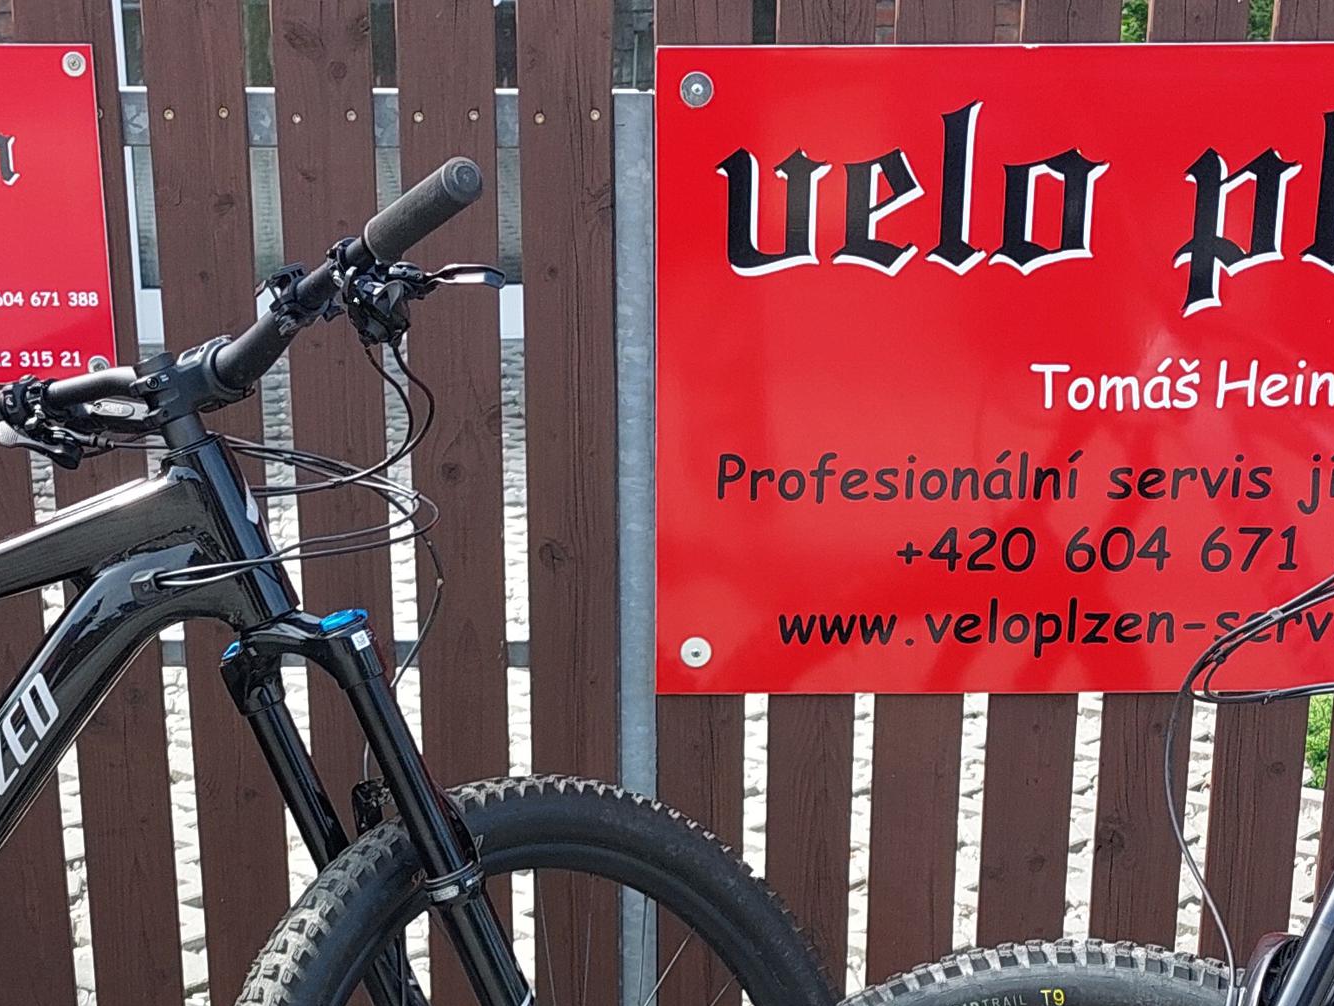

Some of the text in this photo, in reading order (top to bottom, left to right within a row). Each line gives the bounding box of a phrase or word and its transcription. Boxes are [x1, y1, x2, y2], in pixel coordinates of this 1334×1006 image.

[715, 99, 1110, 278] velo
[30, 291, 61, 307] 671
[67, 291, 99, 307] 388
[19, 351, 54, 368] 315
[59, 351, 82, 368] 21
[1030, 357, 1201, 412] Tomáš
[717, 448, 1084, 504] Profesionální
[1107, 453, 1274, 500] servis
[896, 526, 1037, 573] +420
[1064, 526, 1171, 573] 604
[1200, 526, 1298, 573] 671
